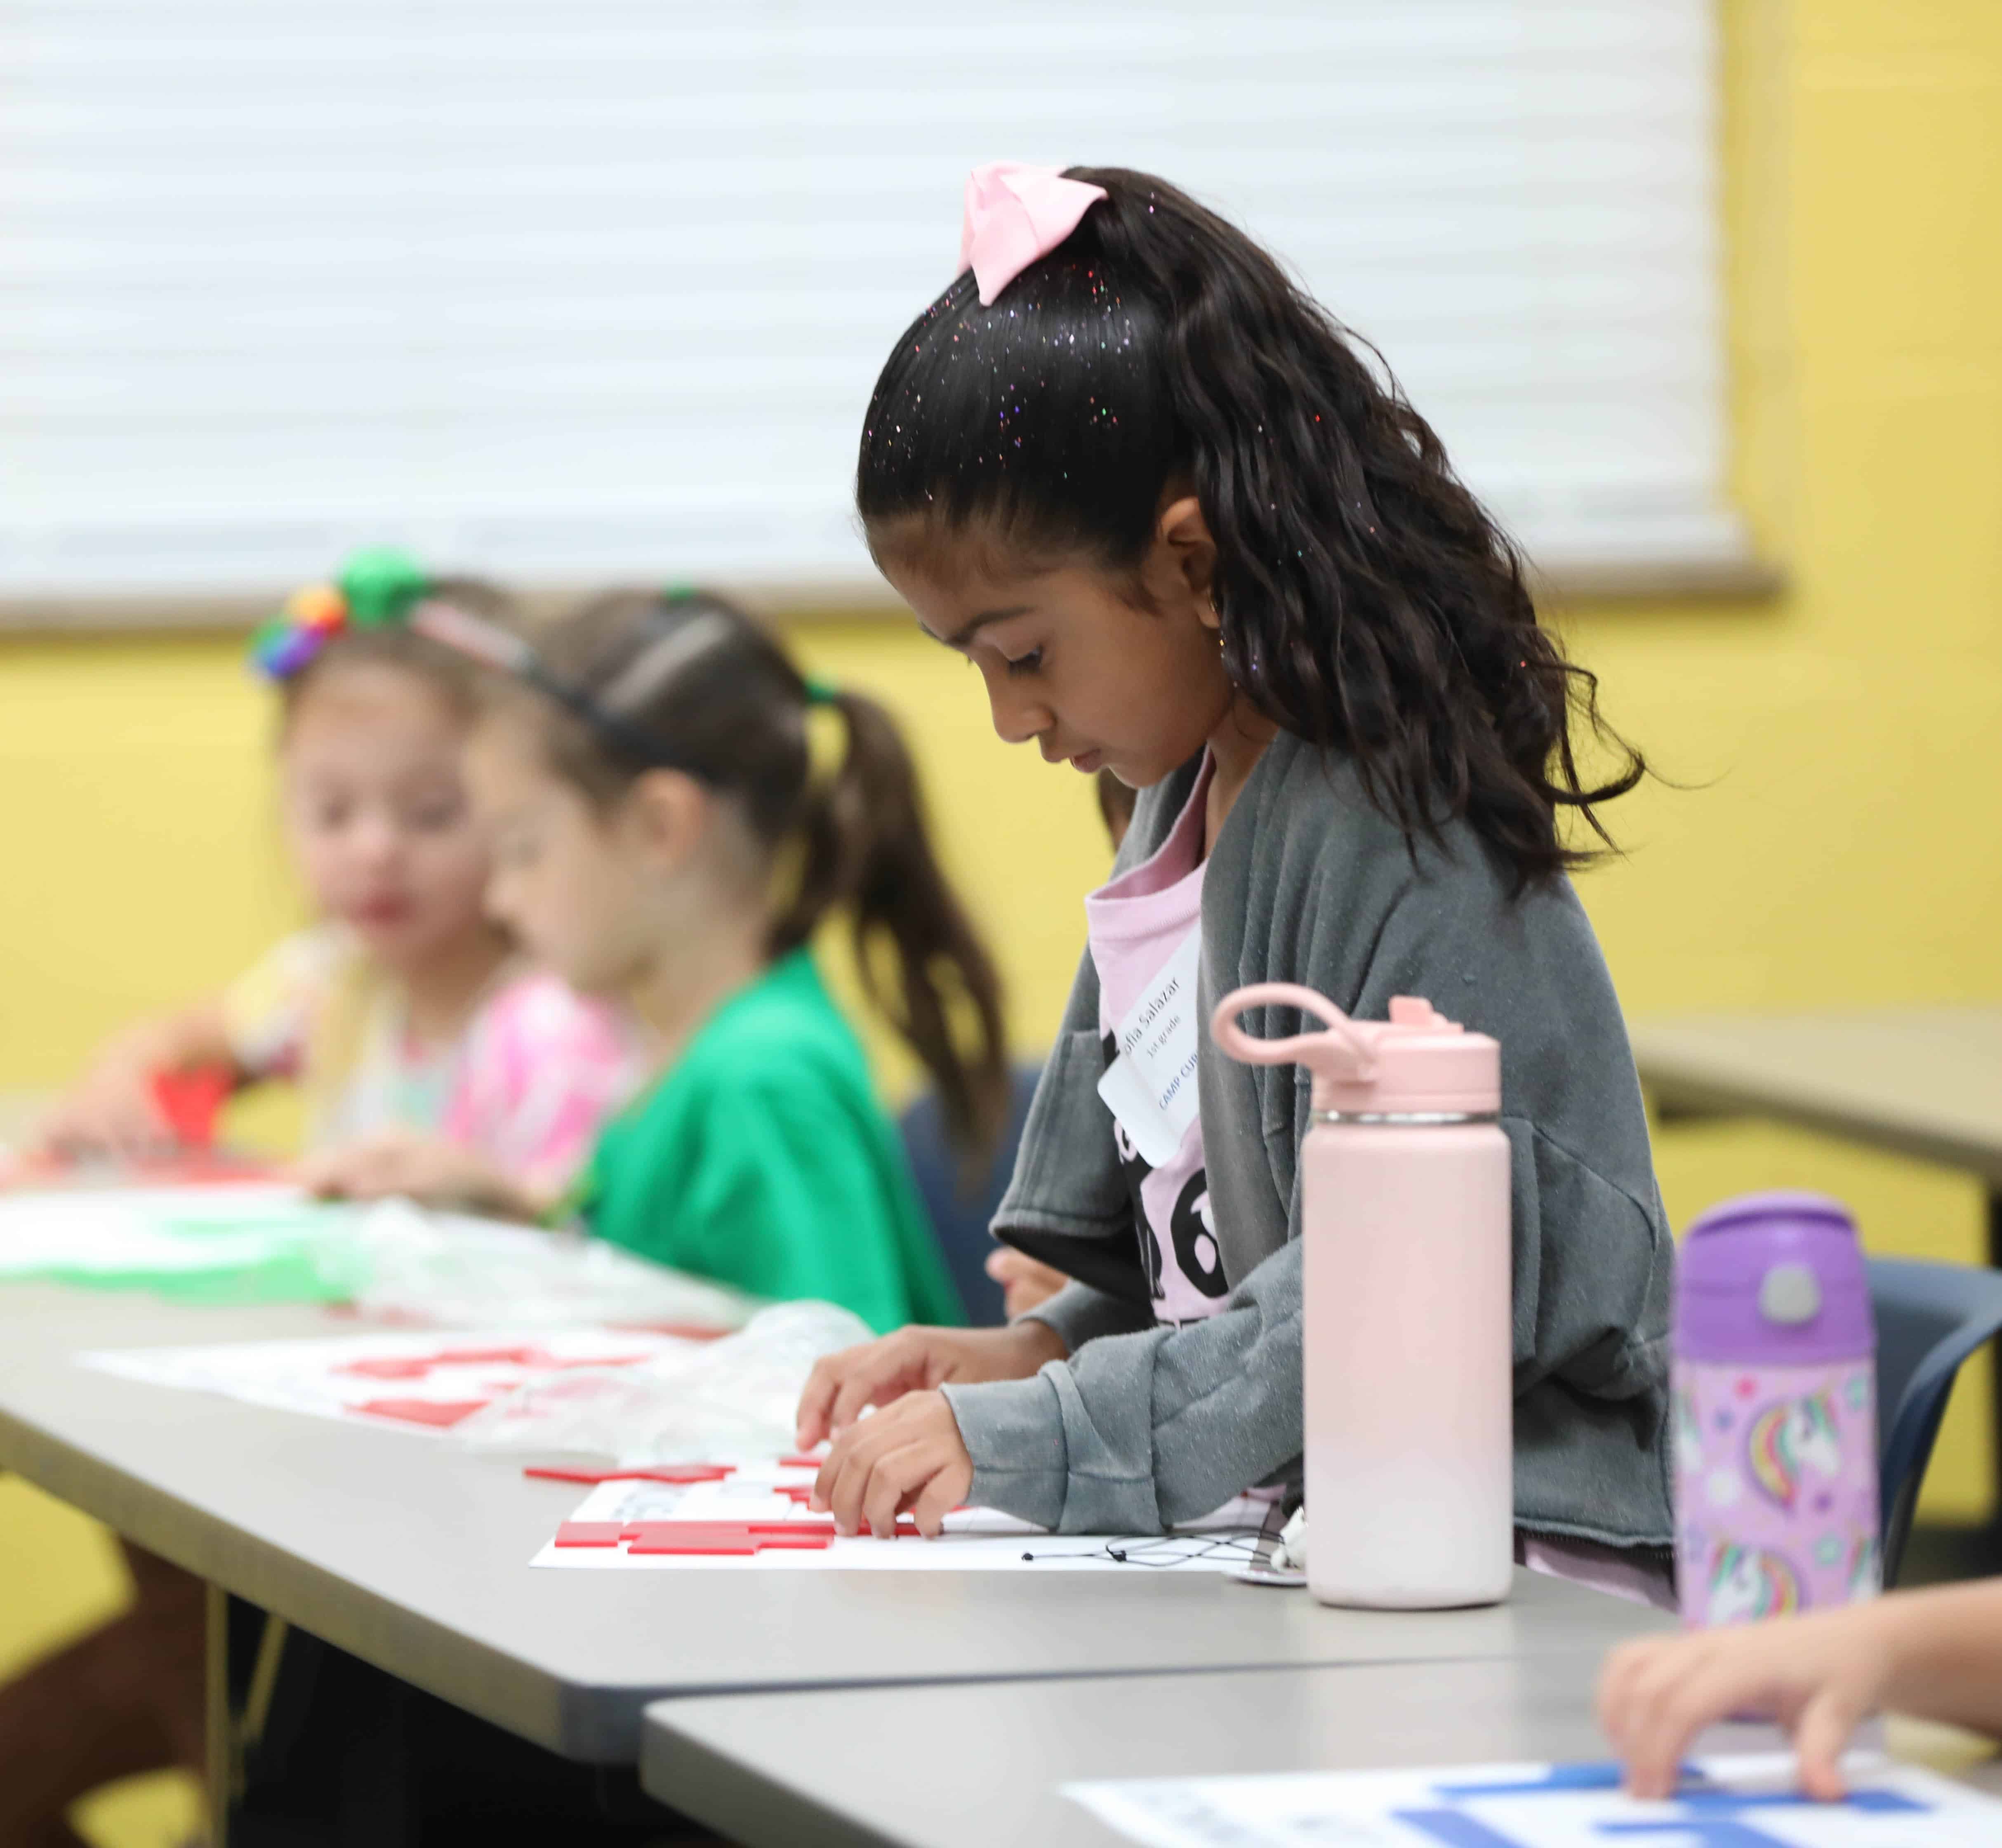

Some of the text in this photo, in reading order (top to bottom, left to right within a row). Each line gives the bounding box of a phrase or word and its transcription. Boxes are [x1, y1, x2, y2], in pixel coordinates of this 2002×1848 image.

[1124, 977, 1180, 1056] ofia Salazar
[1147, 1015, 1181, 1060] 1st grade
[1159, 1076, 1181, 1110] CAMP
